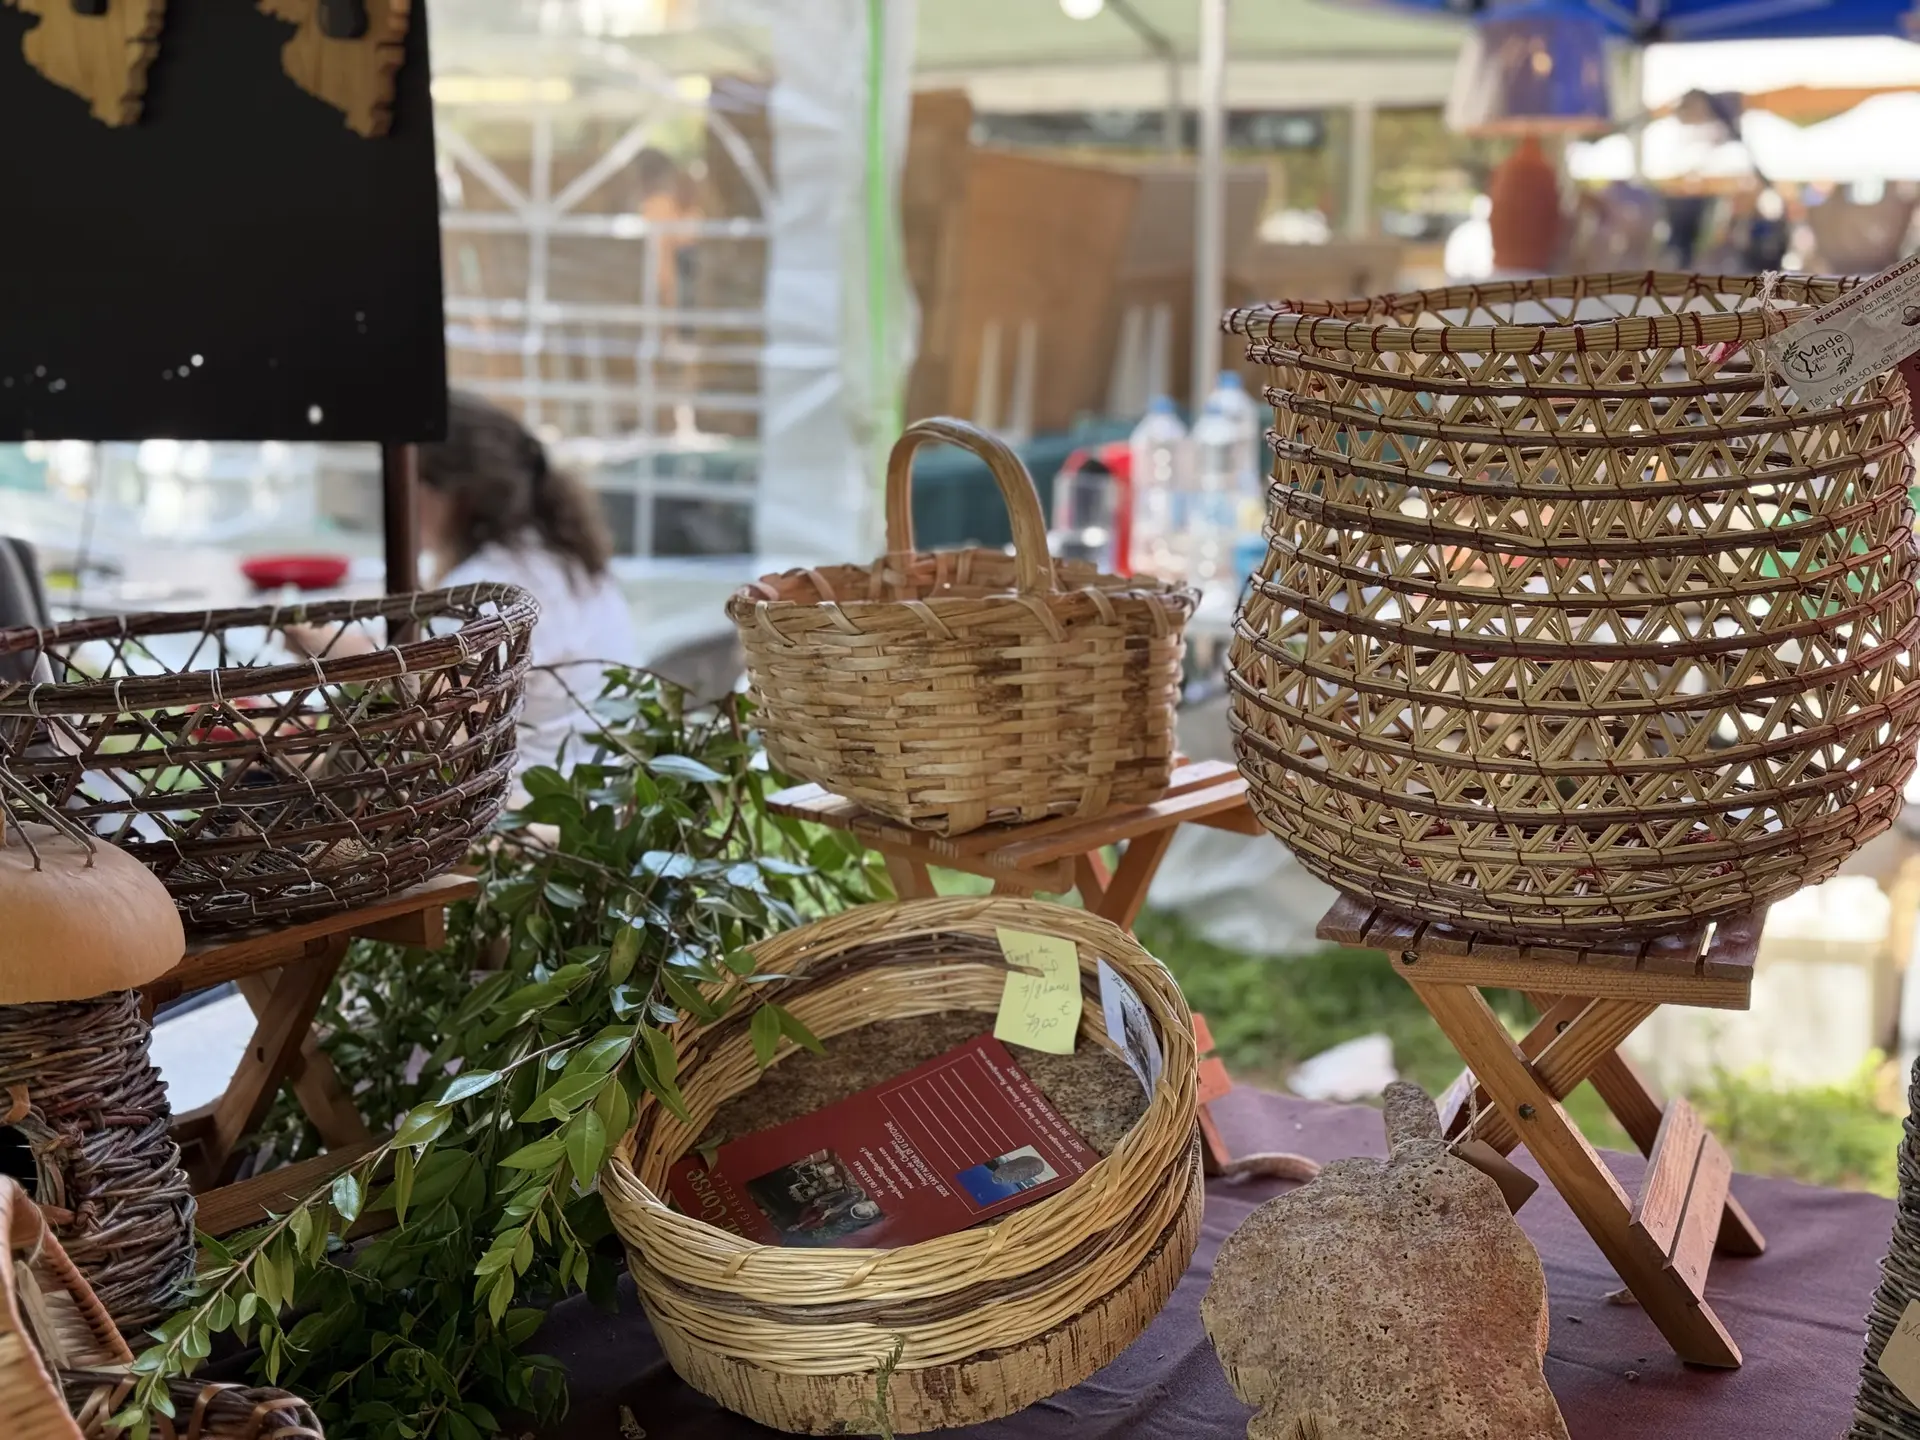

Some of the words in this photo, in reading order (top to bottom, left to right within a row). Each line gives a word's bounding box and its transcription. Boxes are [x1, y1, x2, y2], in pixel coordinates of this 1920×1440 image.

[1814, 294, 1862, 324] Natalina
[1856, 285, 1902, 313] Vannerie
[1798, 334, 1844, 359] Made
[1812, 353, 1829, 365] chez
[1832, 345, 1846, 357] in
[884, 1121, 904, 1143] COTONE
[686, 1168, 727, 1221] Corse
[714, 1172, 758, 1231] FIGARELLA
